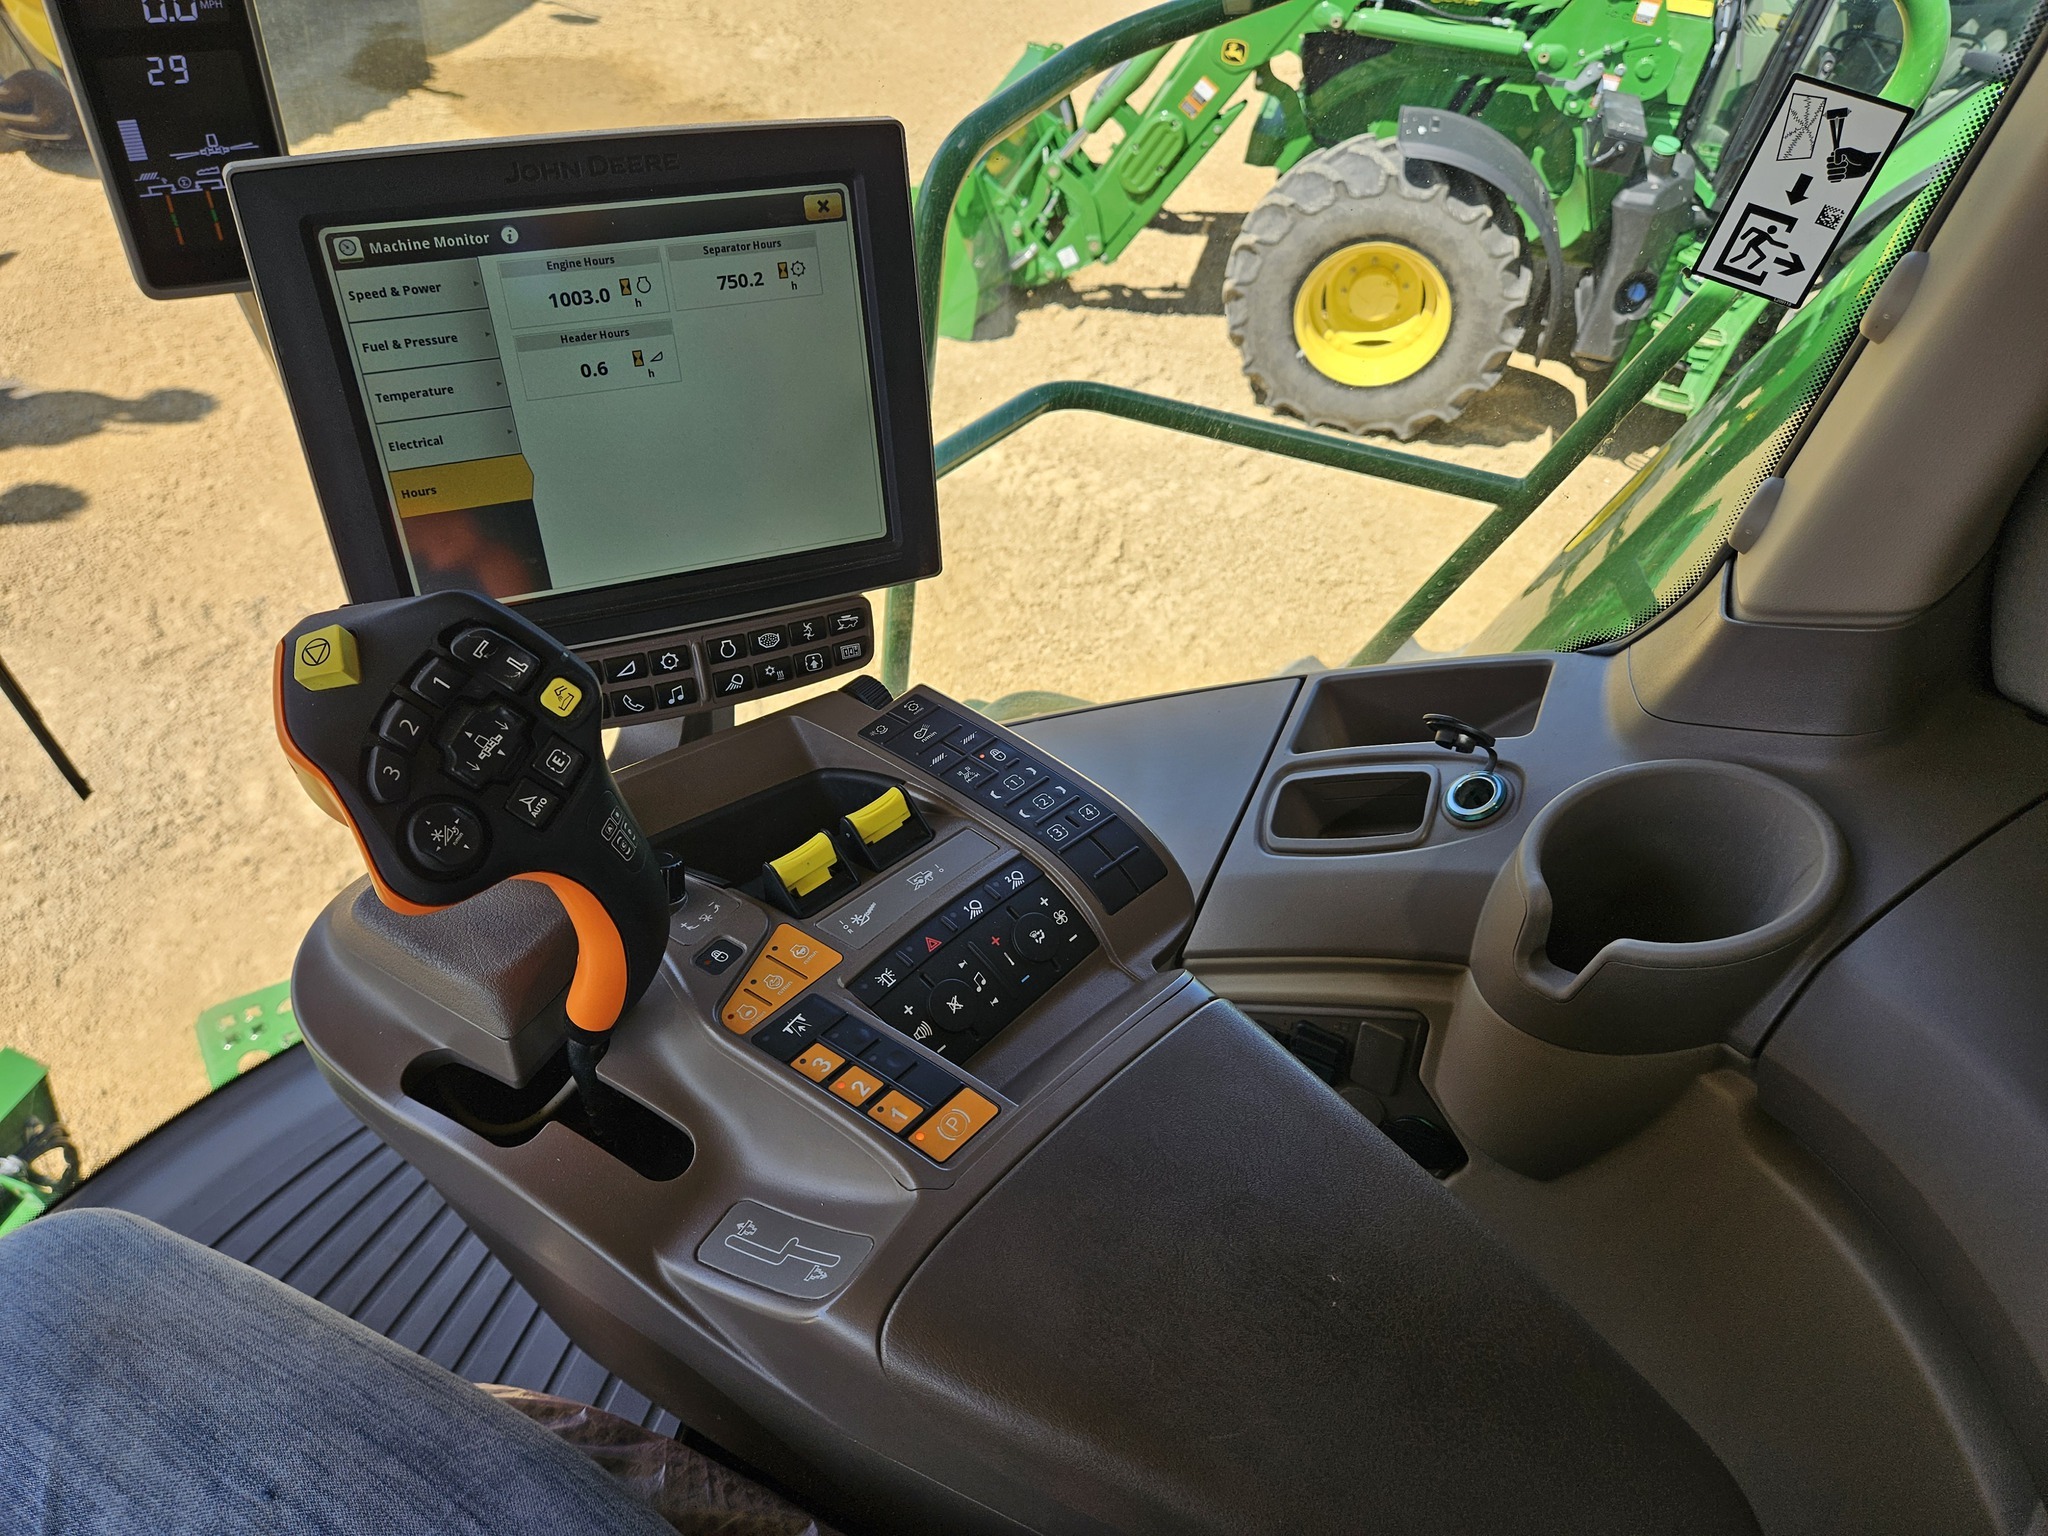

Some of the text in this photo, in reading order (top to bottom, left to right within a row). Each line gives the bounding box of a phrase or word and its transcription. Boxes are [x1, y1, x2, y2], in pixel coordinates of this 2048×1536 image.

[200, 0, 223, 9] MPH
[146, 55, 189, 86] 29
[504, 153, 680, 184] JOHN DEERE
[369, 233, 490, 255] Machine Monitor
[703, 239, 782, 256] Separator Hours
[546, 256, 615, 271] Engine Hours
[716, 272, 764, 290] 750.2
[791, 281, 798, 290] h
[348, 282, 442, 303] Speed & Power
[548, 288, 610, 308] 1003.0
[634, 298, 642, 307] h
[362, 334, 459, 353] Fuel & Pressure
[560, 329, 630, 344] Header Hours
[580, 361, 609, 378] 0.6
[648, 369, 655, 378] h
[375, 385, 455, 403] Temperature
[388, 435, 444, 452] Electrical
[401, 486, 437, 499] Hours
[433, 676, 450, 689] 1
[400, 719, 420, 736] 2
[552, 755, 565, 768] E
[383, 765, 400, 781] 3
[1010, 778, 1019, 787] 1
[531, 797, 548, 818] AUTO
[1038, 797, 1049, 806] 2
[1085, 808, 1095, 817] 4
[1052, 828, 1063, 838] 3
[811, 1057, 832, 1073] 3
[851, 1080, 872, 1098] 2
[890, 1107, 909, 1121] 1
[944, 1117, 959, 1132] P
